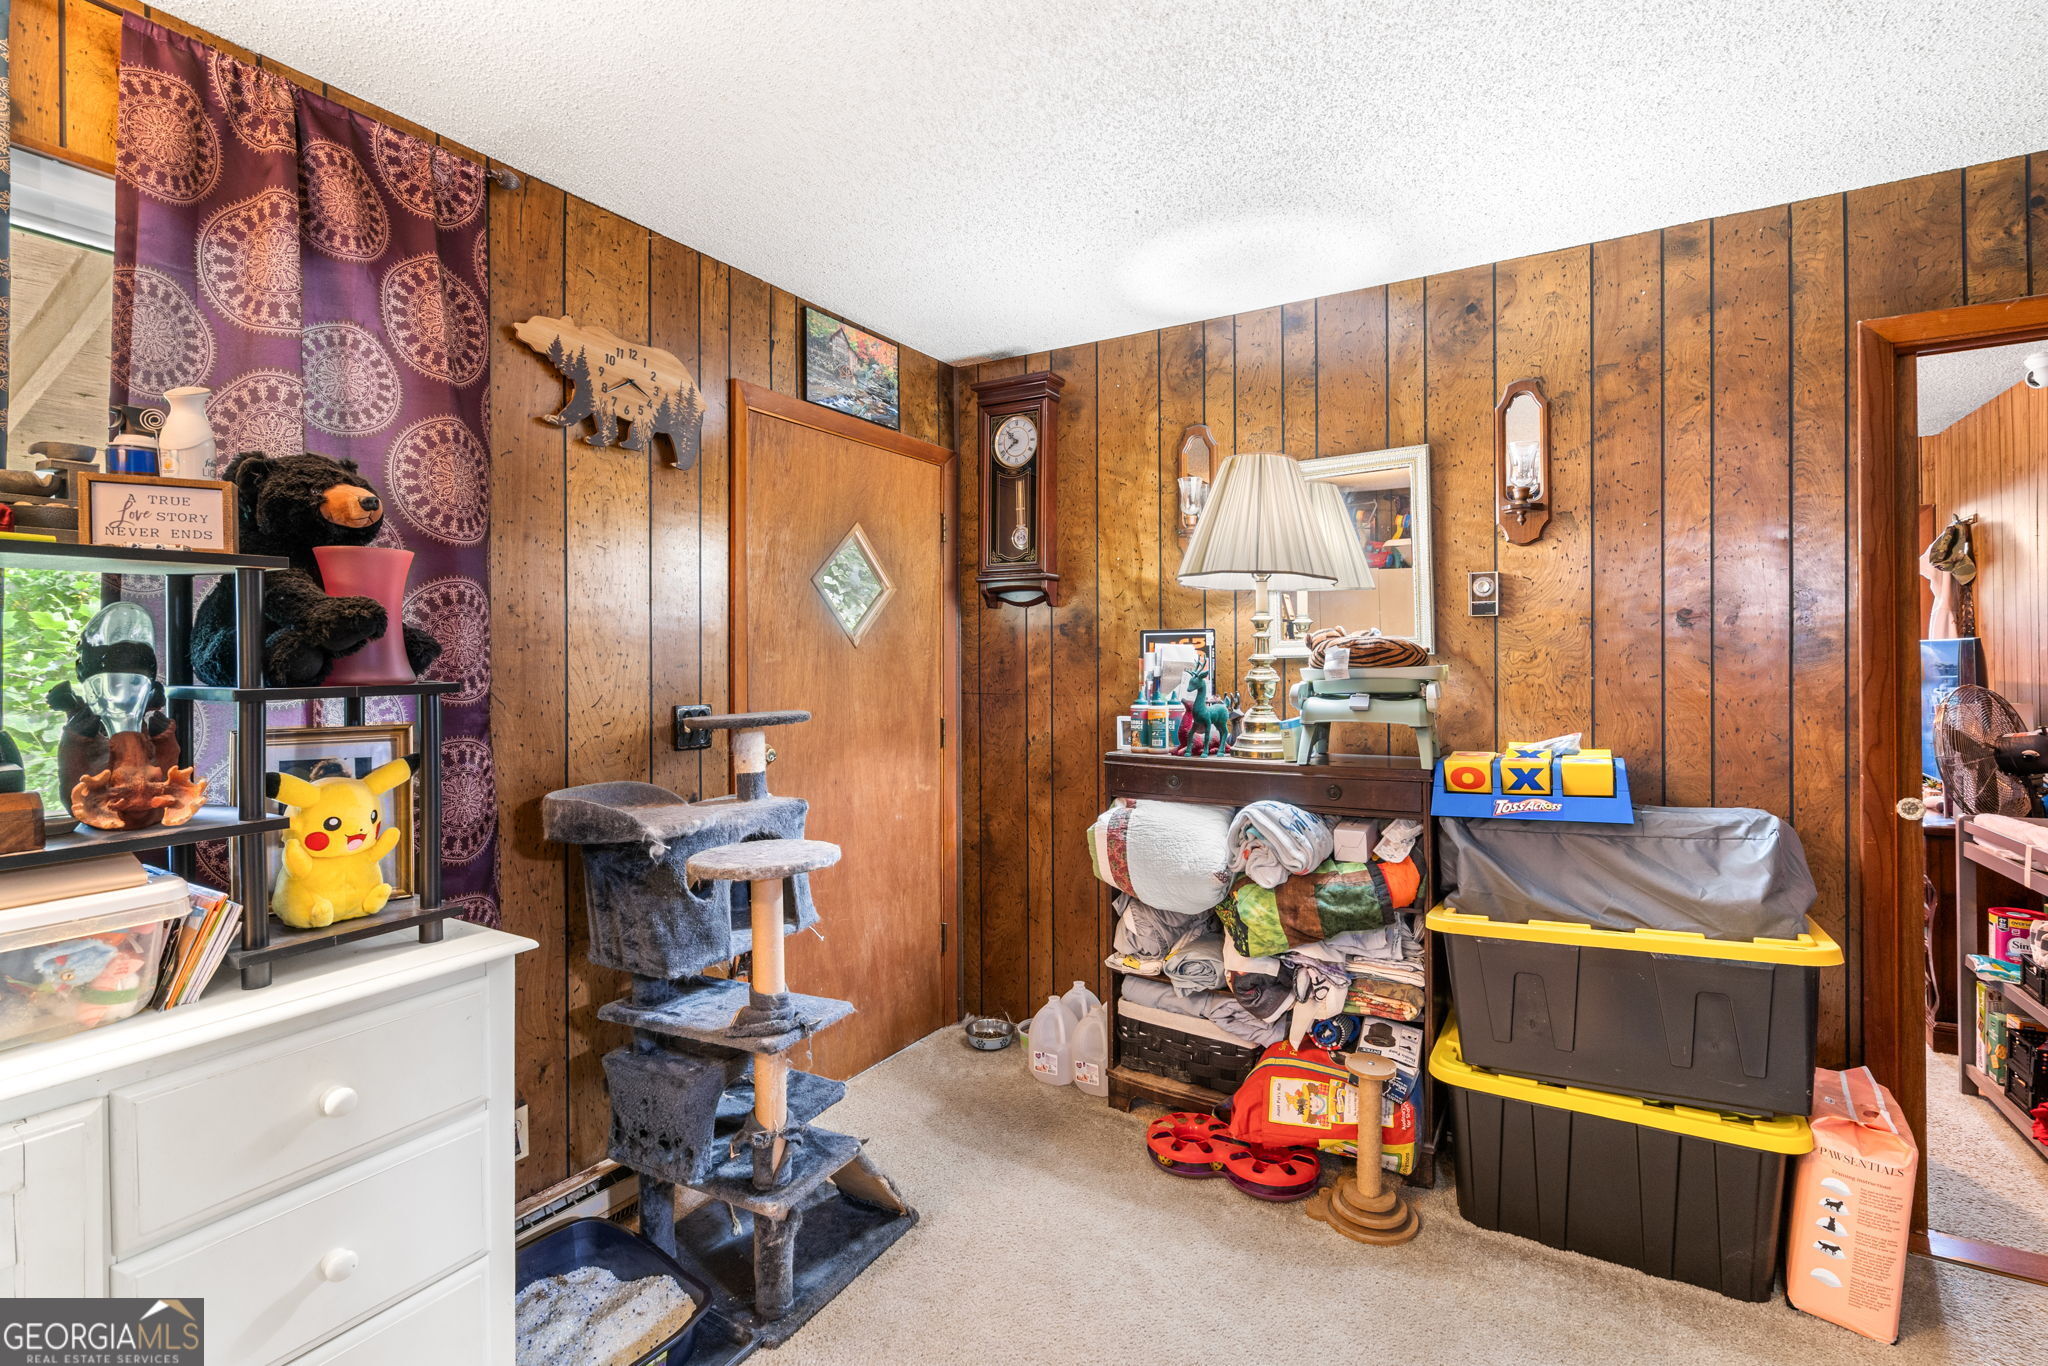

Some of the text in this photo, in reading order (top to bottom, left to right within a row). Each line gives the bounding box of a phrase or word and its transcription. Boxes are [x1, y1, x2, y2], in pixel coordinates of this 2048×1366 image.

[616, 347, 624, 359] 11
[629, 348, 638, 361] 12
[605, 353, 616, 366] 10
[643, 358, 647, 368] 1
[598, 366, 605, 377] 9
[650, 371, 657, 382] 2
[601, 382, 608, 393] 8
[653, 386, 659, 397] 3
[611, 396, 617, 407] 7
[647, 400, 653, 409] 4
[624, 405, 630, 415] 6
[638, 405, 644, 415] 5
[128, 493, 191, 507] A TRUE
[109, 500, 208, 529] Love STORY
[105, 526, 213, 540] NEVER ENDS
[1508, 767, 1545, 791] X
[1819, 1146, 1905, 1177] PAWSENTIALS
